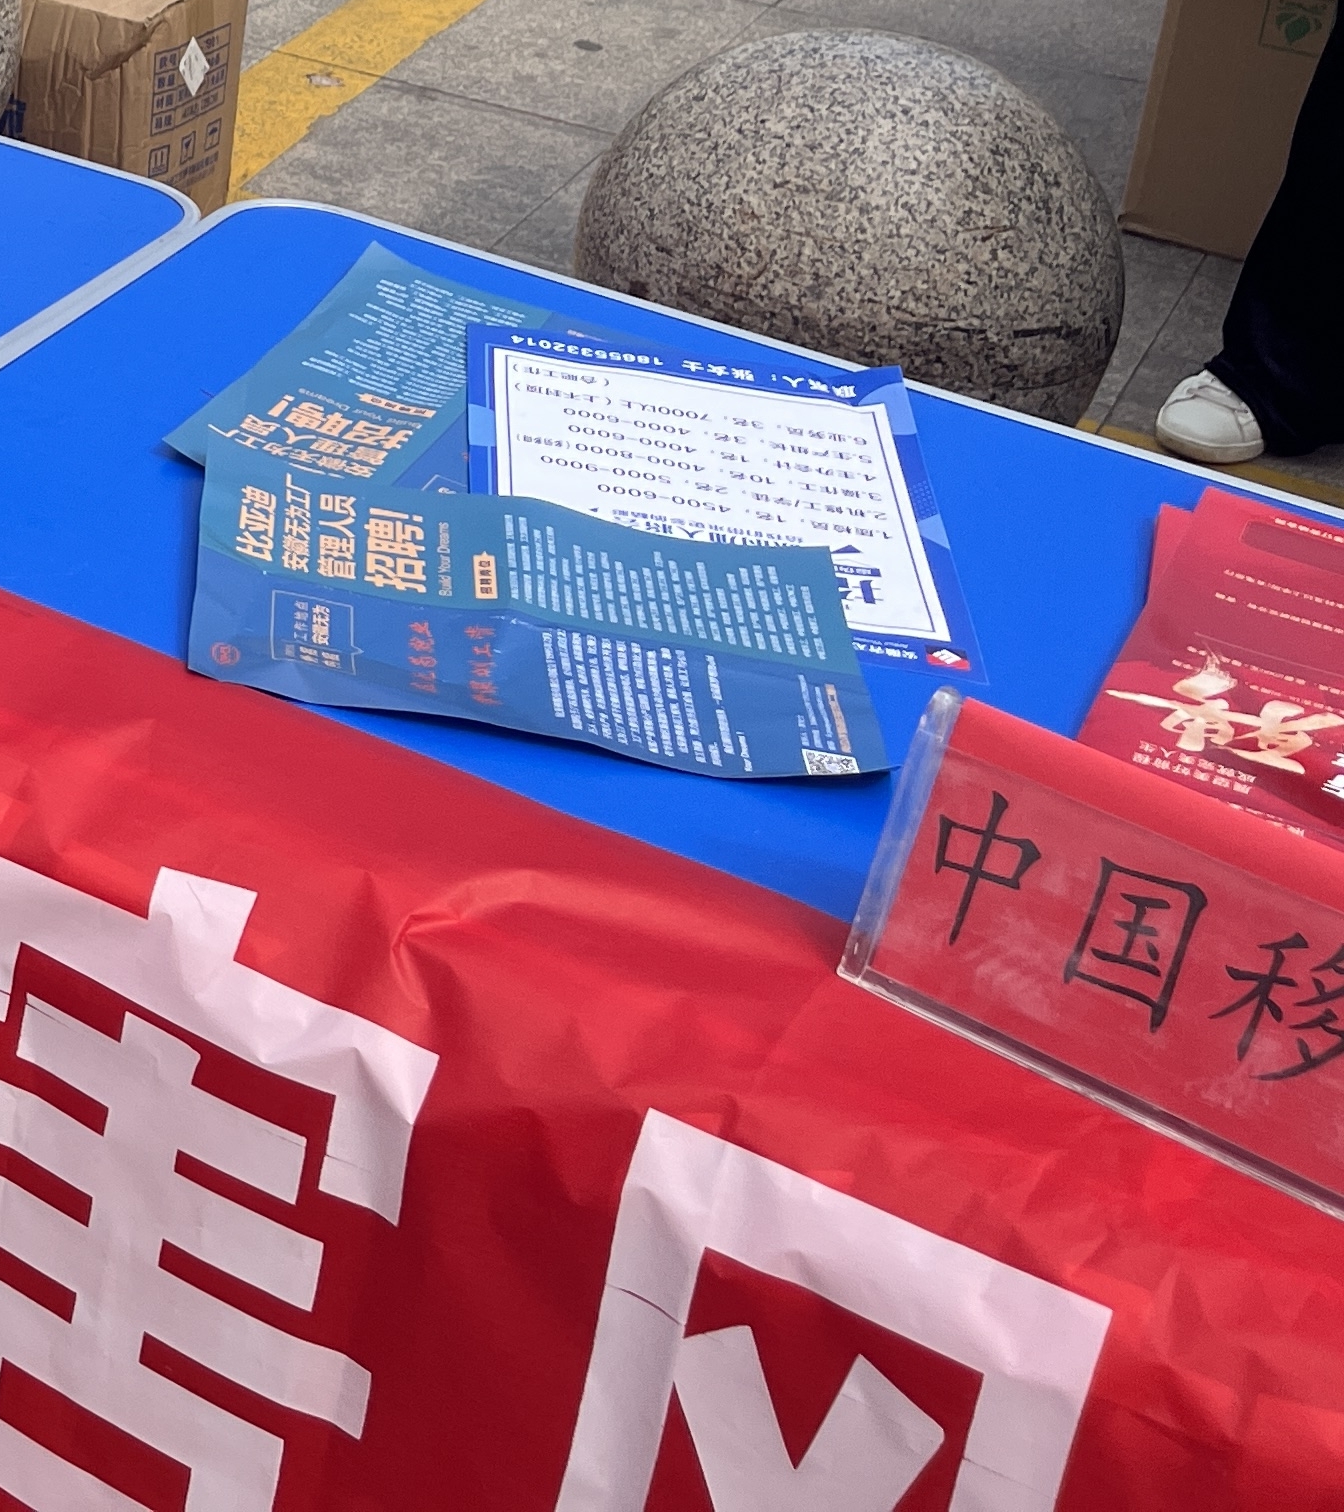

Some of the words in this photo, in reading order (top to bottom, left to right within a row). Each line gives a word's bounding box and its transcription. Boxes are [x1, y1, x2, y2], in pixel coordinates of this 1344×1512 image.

[240, 414, 388, 466] 管理人员
[236, 485, 277, 562] 比亚迪
[281, 473, 311, 574] 安徽无为工厂
[317, 493, 357, 580] 管理人员
[437, 521, 451, 554] Dreams
[437, 554, 450, 573] Your
[437, 573, 453, 597] Build
[933, 790, 1344, 1081] 中国移
